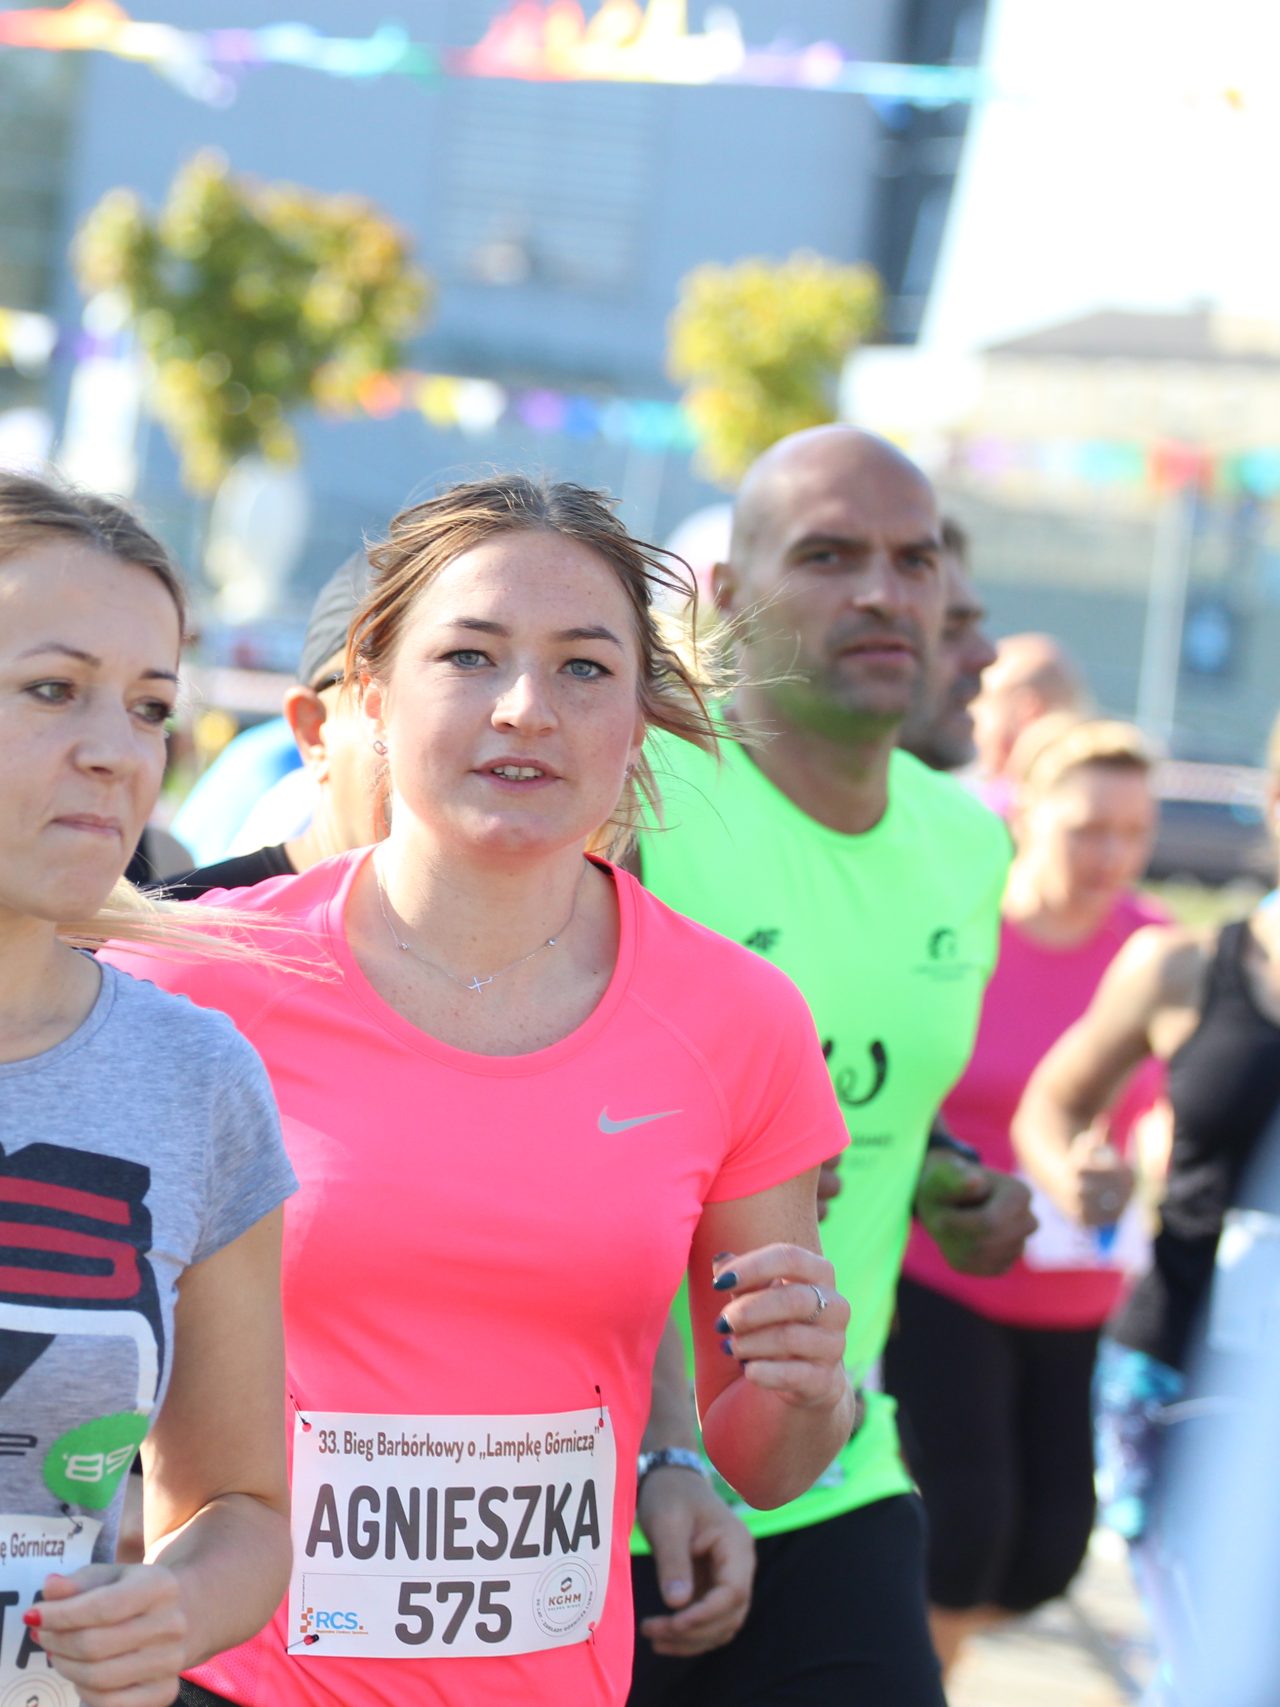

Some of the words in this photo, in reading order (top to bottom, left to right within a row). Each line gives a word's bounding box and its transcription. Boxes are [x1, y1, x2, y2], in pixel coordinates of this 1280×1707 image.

[319, 1430, 340, 1454] 33.
[344, 1430, 374, 1461] Bieg
[377, 1431, 463, 1463] Barbórkowy
[467, 1440, 476, 1457] o
[305, 1479, 600, 1561] AGNIESZKA
[395, 1580, 512, 1645] 575
[548, 1593, 581, 1606] KGHM
